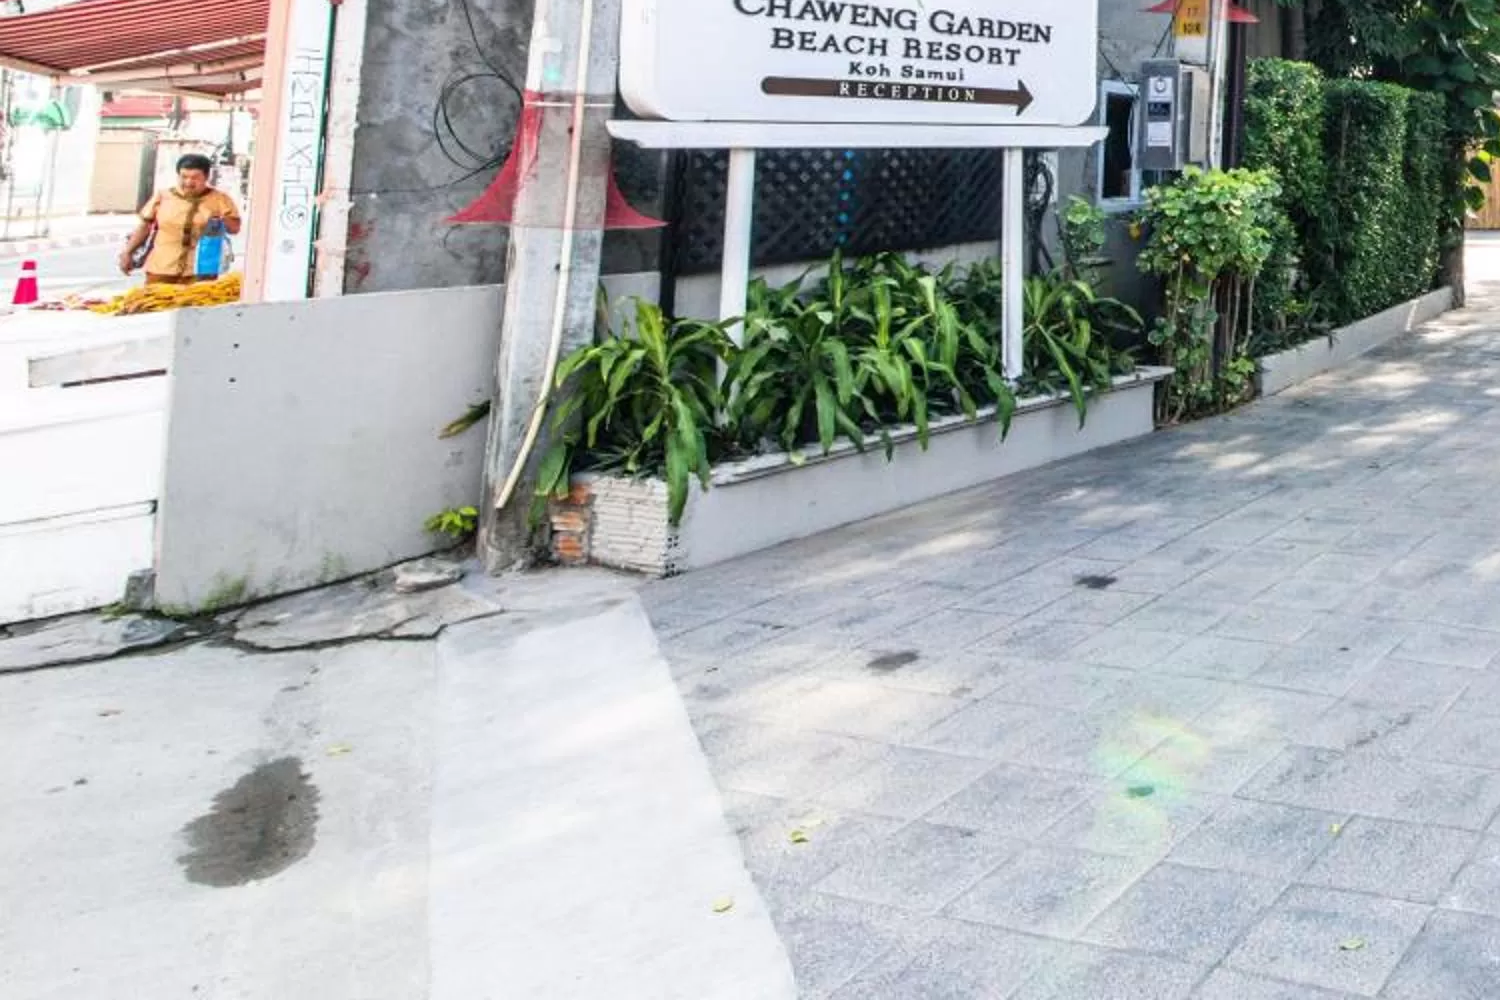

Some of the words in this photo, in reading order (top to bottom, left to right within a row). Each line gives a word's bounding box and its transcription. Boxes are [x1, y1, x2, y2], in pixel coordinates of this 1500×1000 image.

[929, 9, 1052, 44] GARDEN
[771, 27, 888, 57] BEACH
[903, 37, 1021, 67] RESORT
[848, 61, 891, 77] Koh
[901, 65, 964, 81] Samui
[839, 82, 976, 100] RECEPTION
